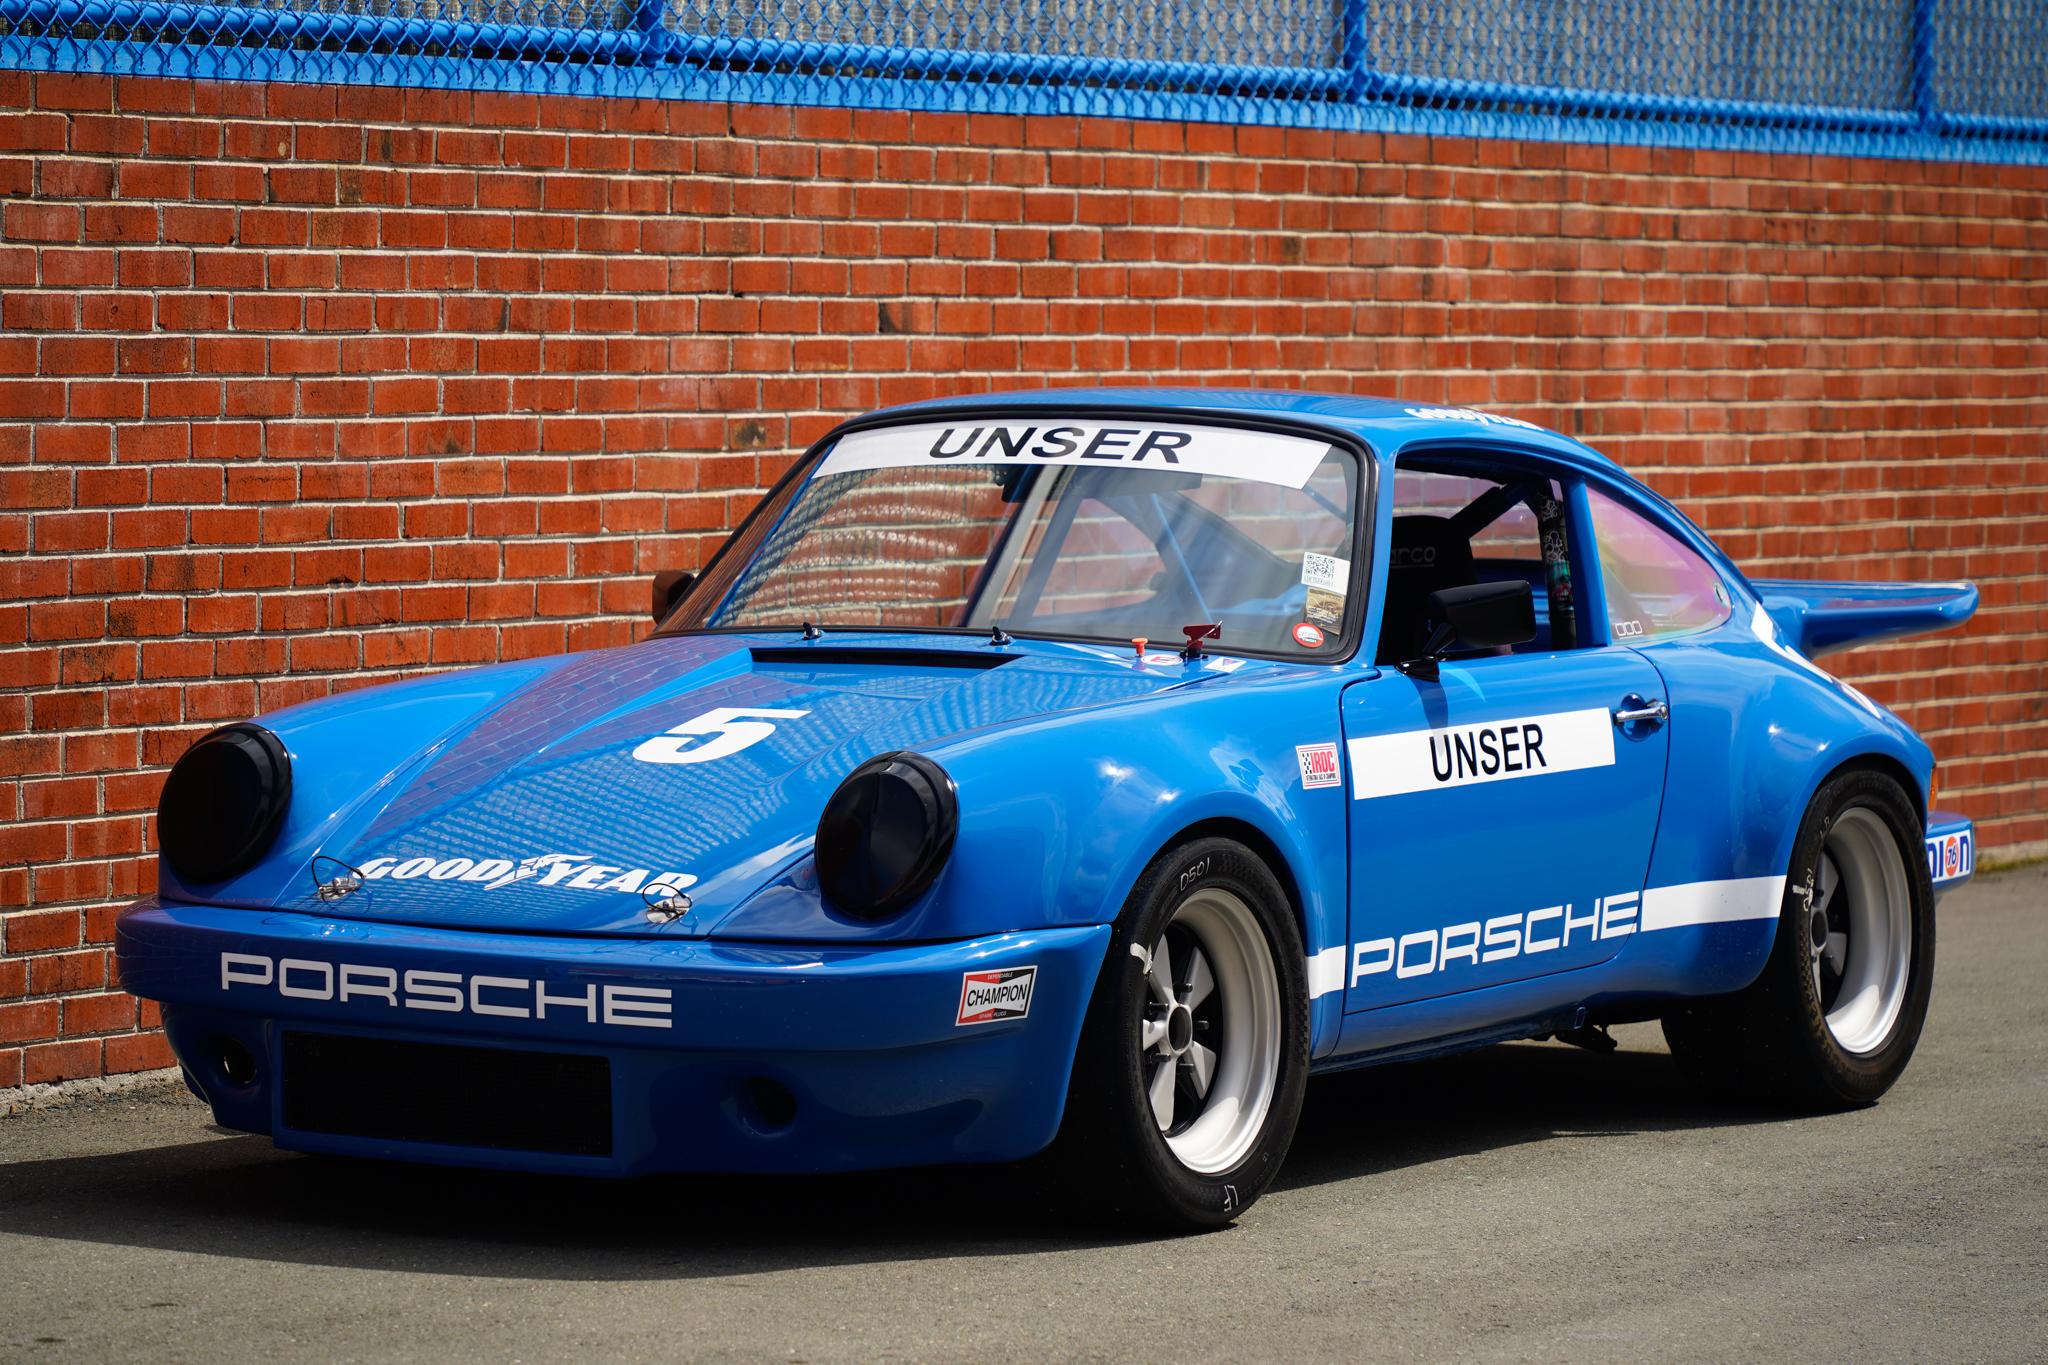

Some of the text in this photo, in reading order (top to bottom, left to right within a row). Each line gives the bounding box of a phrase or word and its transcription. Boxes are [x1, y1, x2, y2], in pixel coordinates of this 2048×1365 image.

[929, 427, 1192, 464] UNSER
[632, 707, 812, 764] 5
[1310, 750, 1336, 774] IROC
[1429, 723, 1547, 782] UNSER
[1946, 845, 1958, 867] 76
[1350, 891, 1640, 988] PORSCHE
[221, 952, 673, 1028] PORSCHE
[987, 972, 1013, 980] DEPENDABLE
[967, 984, 1028, 1007] CHAMPION
[1224, 1184, 1240, 1212] LF
